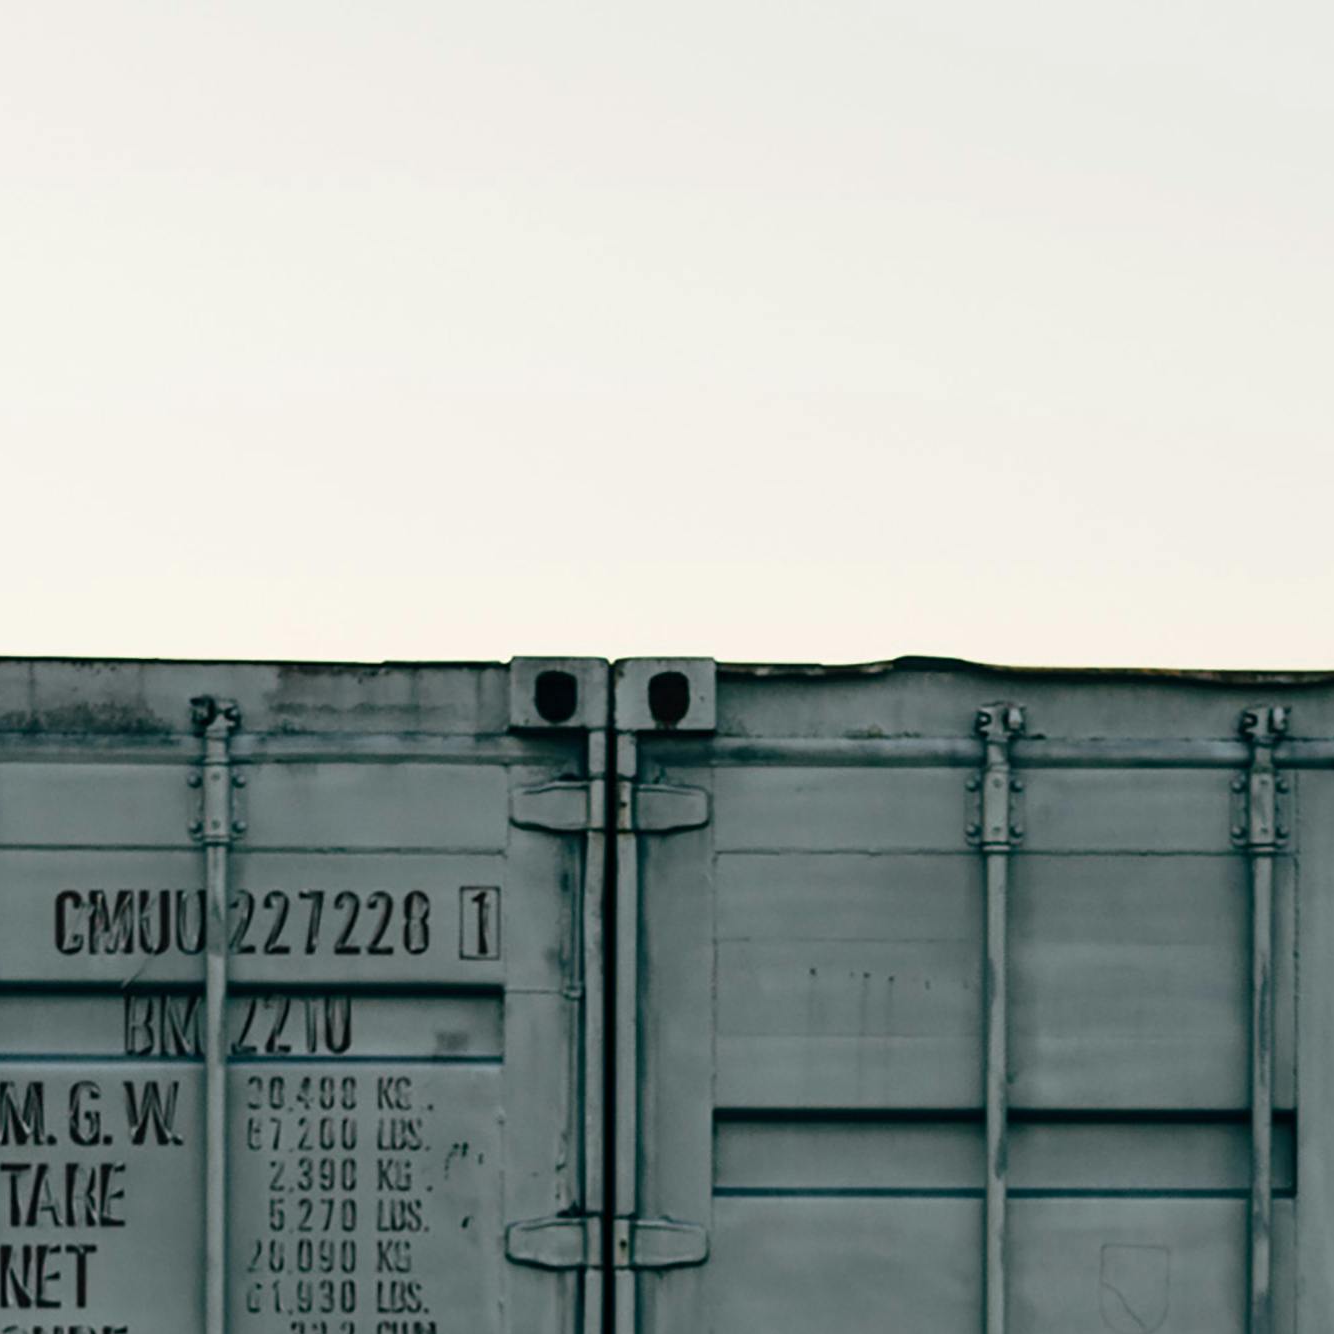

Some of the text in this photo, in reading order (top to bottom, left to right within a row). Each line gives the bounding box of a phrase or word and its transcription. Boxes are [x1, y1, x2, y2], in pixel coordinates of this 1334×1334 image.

[54, 889, 491, 956] CMUU 227228 1
[0, 1162, 127, 1228] TARE
[0, 1244, 97, 1309] NET
